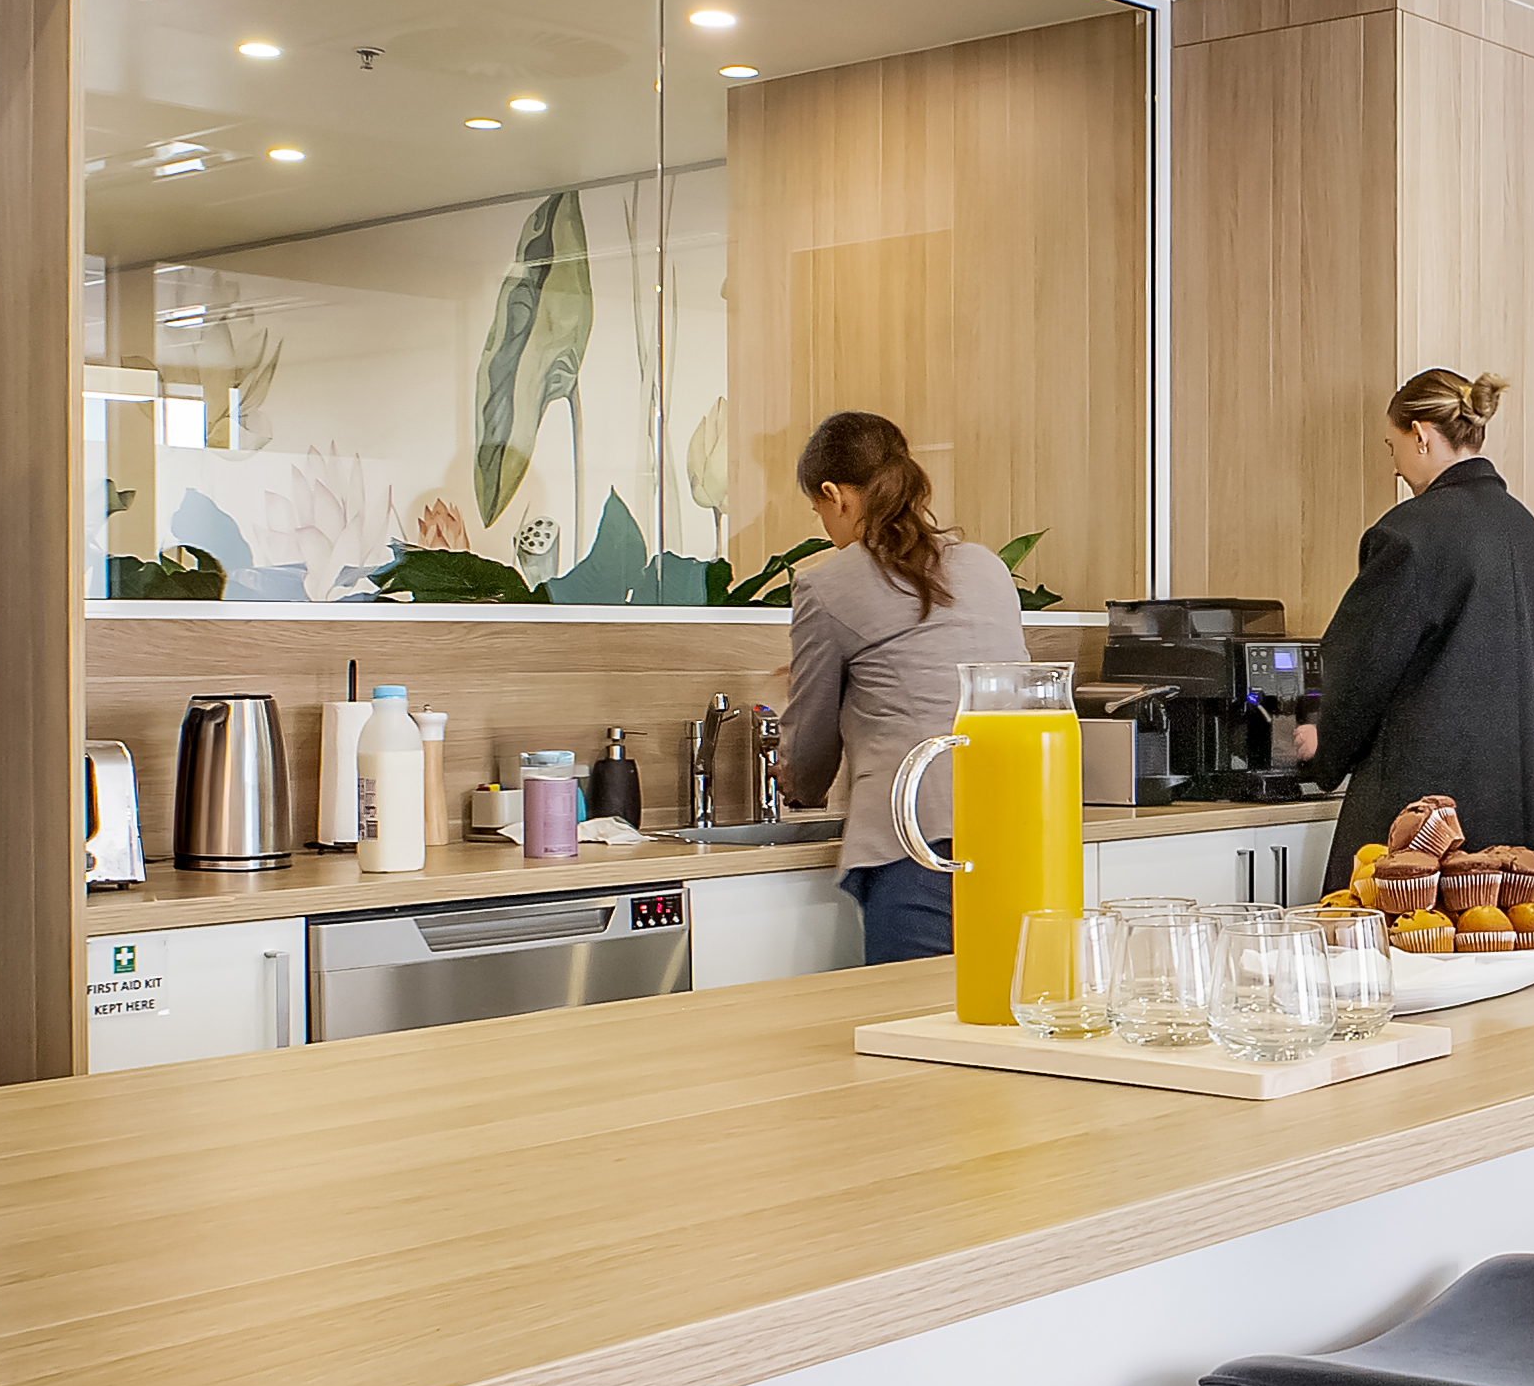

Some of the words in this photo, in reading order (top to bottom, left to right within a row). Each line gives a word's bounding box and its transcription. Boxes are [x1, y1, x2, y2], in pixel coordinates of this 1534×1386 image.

[86, 982, 119, 995] FIRST
[121, 980, 141, 991] AID
[145, 978, 162, 988] KIT
[94, 1003, 122, 1015] KEPT
[126, 999, 155, 1011] HERE
